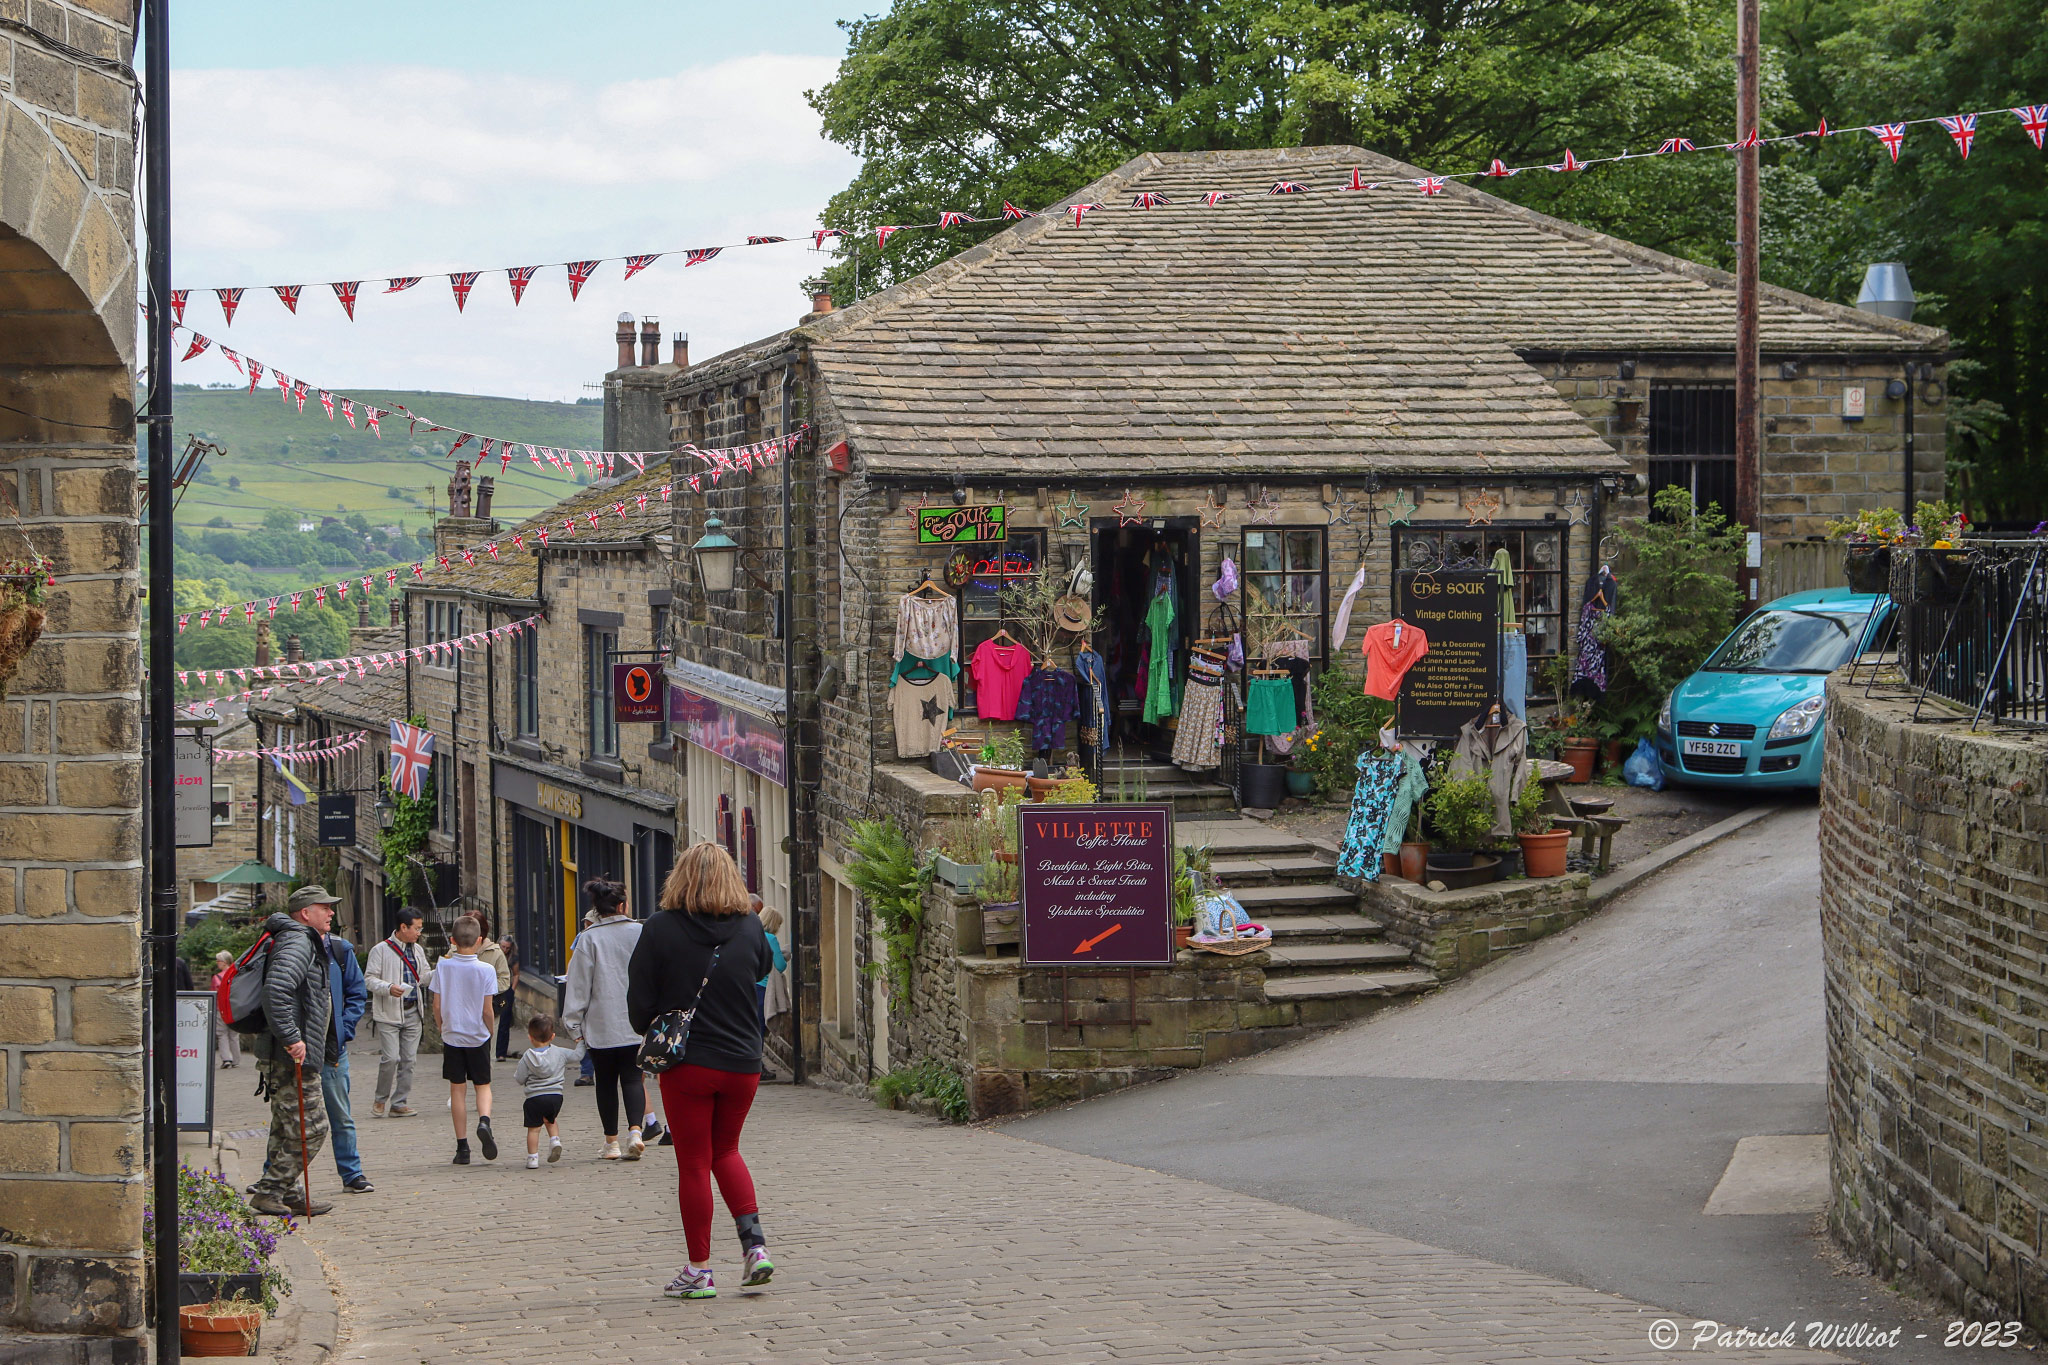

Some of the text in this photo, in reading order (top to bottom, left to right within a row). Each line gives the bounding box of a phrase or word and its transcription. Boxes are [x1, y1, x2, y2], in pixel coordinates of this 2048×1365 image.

[924, 516, 940, 528] The
[976, 522, 1002, 540] 117
[1415, 609, 1482, 622] Vintage Clothing
[1448, 699, 1482, 707] Jewellery.
[1688, 741, 1737, 755] YF58 ZZC
[1036, 822, 1153, 838] VILLETTE
[1076, 833, 1148, 849] Coffee House
[1036, 859, 1090, 873] Breakfasts,
[1093, 859, 1123, 873] Light
[1043, 874, 1147, 886] Meals & Sweet Treats
[1074, 891, 1117, 903] including
[1047, 904, 1146, 919] Yorkshire Specialities
